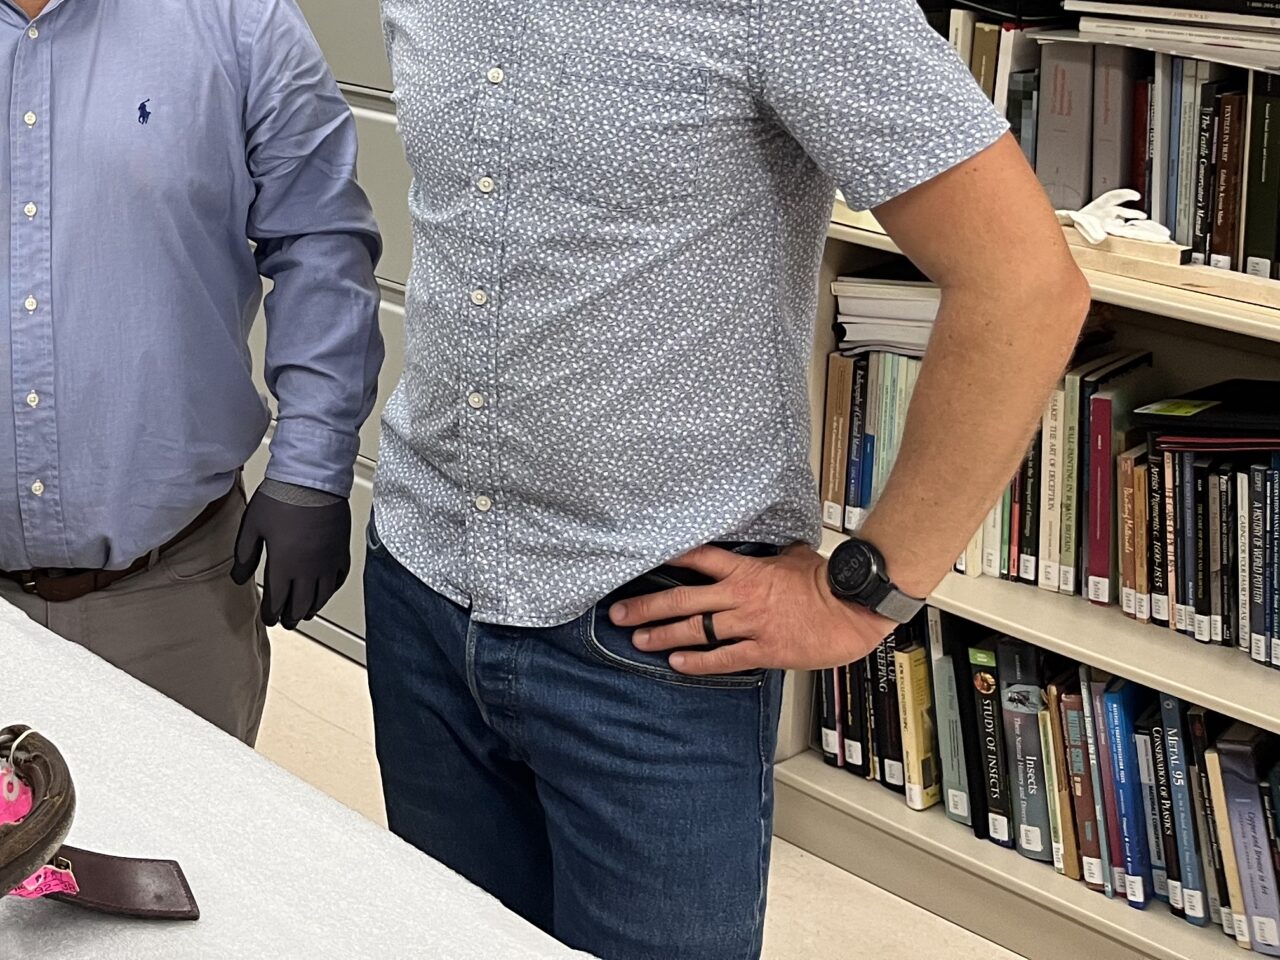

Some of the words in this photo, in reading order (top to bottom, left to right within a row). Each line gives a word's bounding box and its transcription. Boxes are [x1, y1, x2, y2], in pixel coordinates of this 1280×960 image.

[1201, 115, 1209, 129] The
[1223, 104, 1231, 134] TEXTILES
[1199, 131, 1209, 156] Textile
[1223, 134, 1229, 142] IN
[1196, 158, 1208, 207] Conservator's
[1194, 208, 1205, 237] Manual
[1049, 425, 1057, 440] THE
[1048, 442, 1056, 455] ART
[1048, 458, 1056, 468] OF
[1048, 470, 1056, 511] DECEPTION
[1066, 483, 1073, 493] IN
[1151, 464, 1161, 493] Artists'
[1254, 471, 1262, 491] COOPER
[1123, 487, 1134, 518] Painting
[1150, 492, 1162, 530] Pigments
[1197, 530, 1203, 538] OF
[1239, 514, 1247, 537] CARING
[1253, 507, 1262, 536] HISTORY
[1063, 523, 1072, 553] BRITAIN
[1124, 519, 1135, 553] Materials
[1239, 539, 1247, 555] FOR
[1253, 537, 1262, 547] OF
[1253, 547, 1263, 573] WORLD
[1253, 573, 1262, 604] POTTERY
[887, 666, 896, 683] OF
[982, 698, 997, 736] STUDY
[1013, 717, 1022, 735] Their
[1084, 716, 1094, 738] Science
[986, 737, 997, 752] OF
[1015, 736, 1025, 761] Natural
[1088, 743, 1096, 753] the
[1152, 727, 1167, 785] CONSERVATION
[1166, 727, 1179, 767] METAL
[987, 755, 1000, 799] INSECTS
[1015, 761, 1026, 786] History
[1025, 755, 1038, 795] Insects
[1172, 770, 1184, 786] 95
[1019, 787, 1027, 800] and
[1160, 787, 1169, 799] OF
[1161, 799, 1173, 835] PLASTICS
[1246, 810, 1258, 835] Copper
[1251, 834, 1261, 849] and
[1252, 849, 1265, 874] Bronze
[1260, 884, 1270, 895] Art
